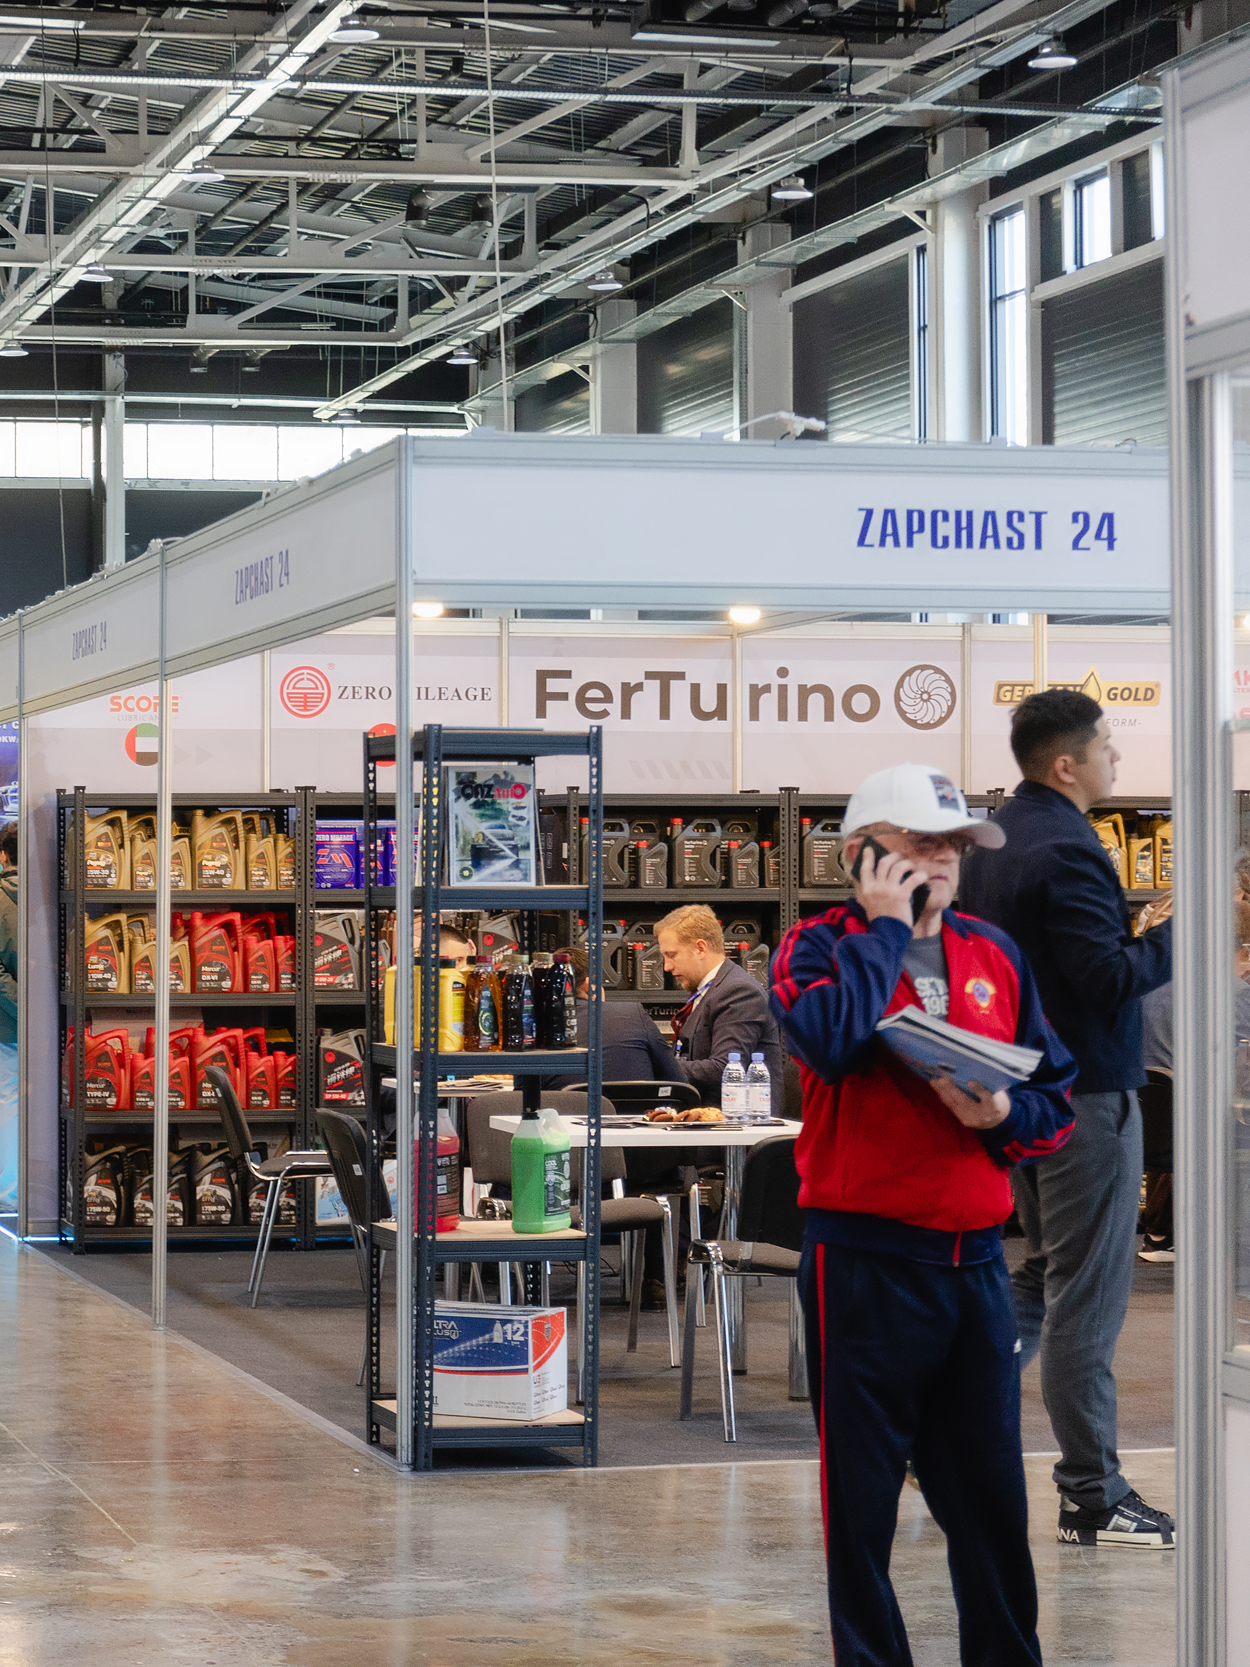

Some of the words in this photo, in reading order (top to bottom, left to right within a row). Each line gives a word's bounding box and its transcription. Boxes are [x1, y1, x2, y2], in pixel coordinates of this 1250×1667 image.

[857, 508, 1048, 551] ZAPCHAST
[1071, 511, 1118, 552] 24
[235, 555, 274, 605] ZAPCHAST
[278, 549, 290, 588] 24
[72, 624, 98, 661] ZAPCHAST
[338, 685, 392, 700] ZERO
[416, 687, 492, 701] ILEAGE
[536, 668, 881, 724] FerTurino
[1107, 687, 1155, 702] GOLD
[117, 714, 159, 722] LUBRICAN
[1105, 718, 1142, 728] FORM-
[642, 1005, 680, 1016] erTurin
[434, 1320, 458, 1330] LTRA
[503, 1323, 525, 1341] 12
[1056, 1527, 1080, 1543] NA
